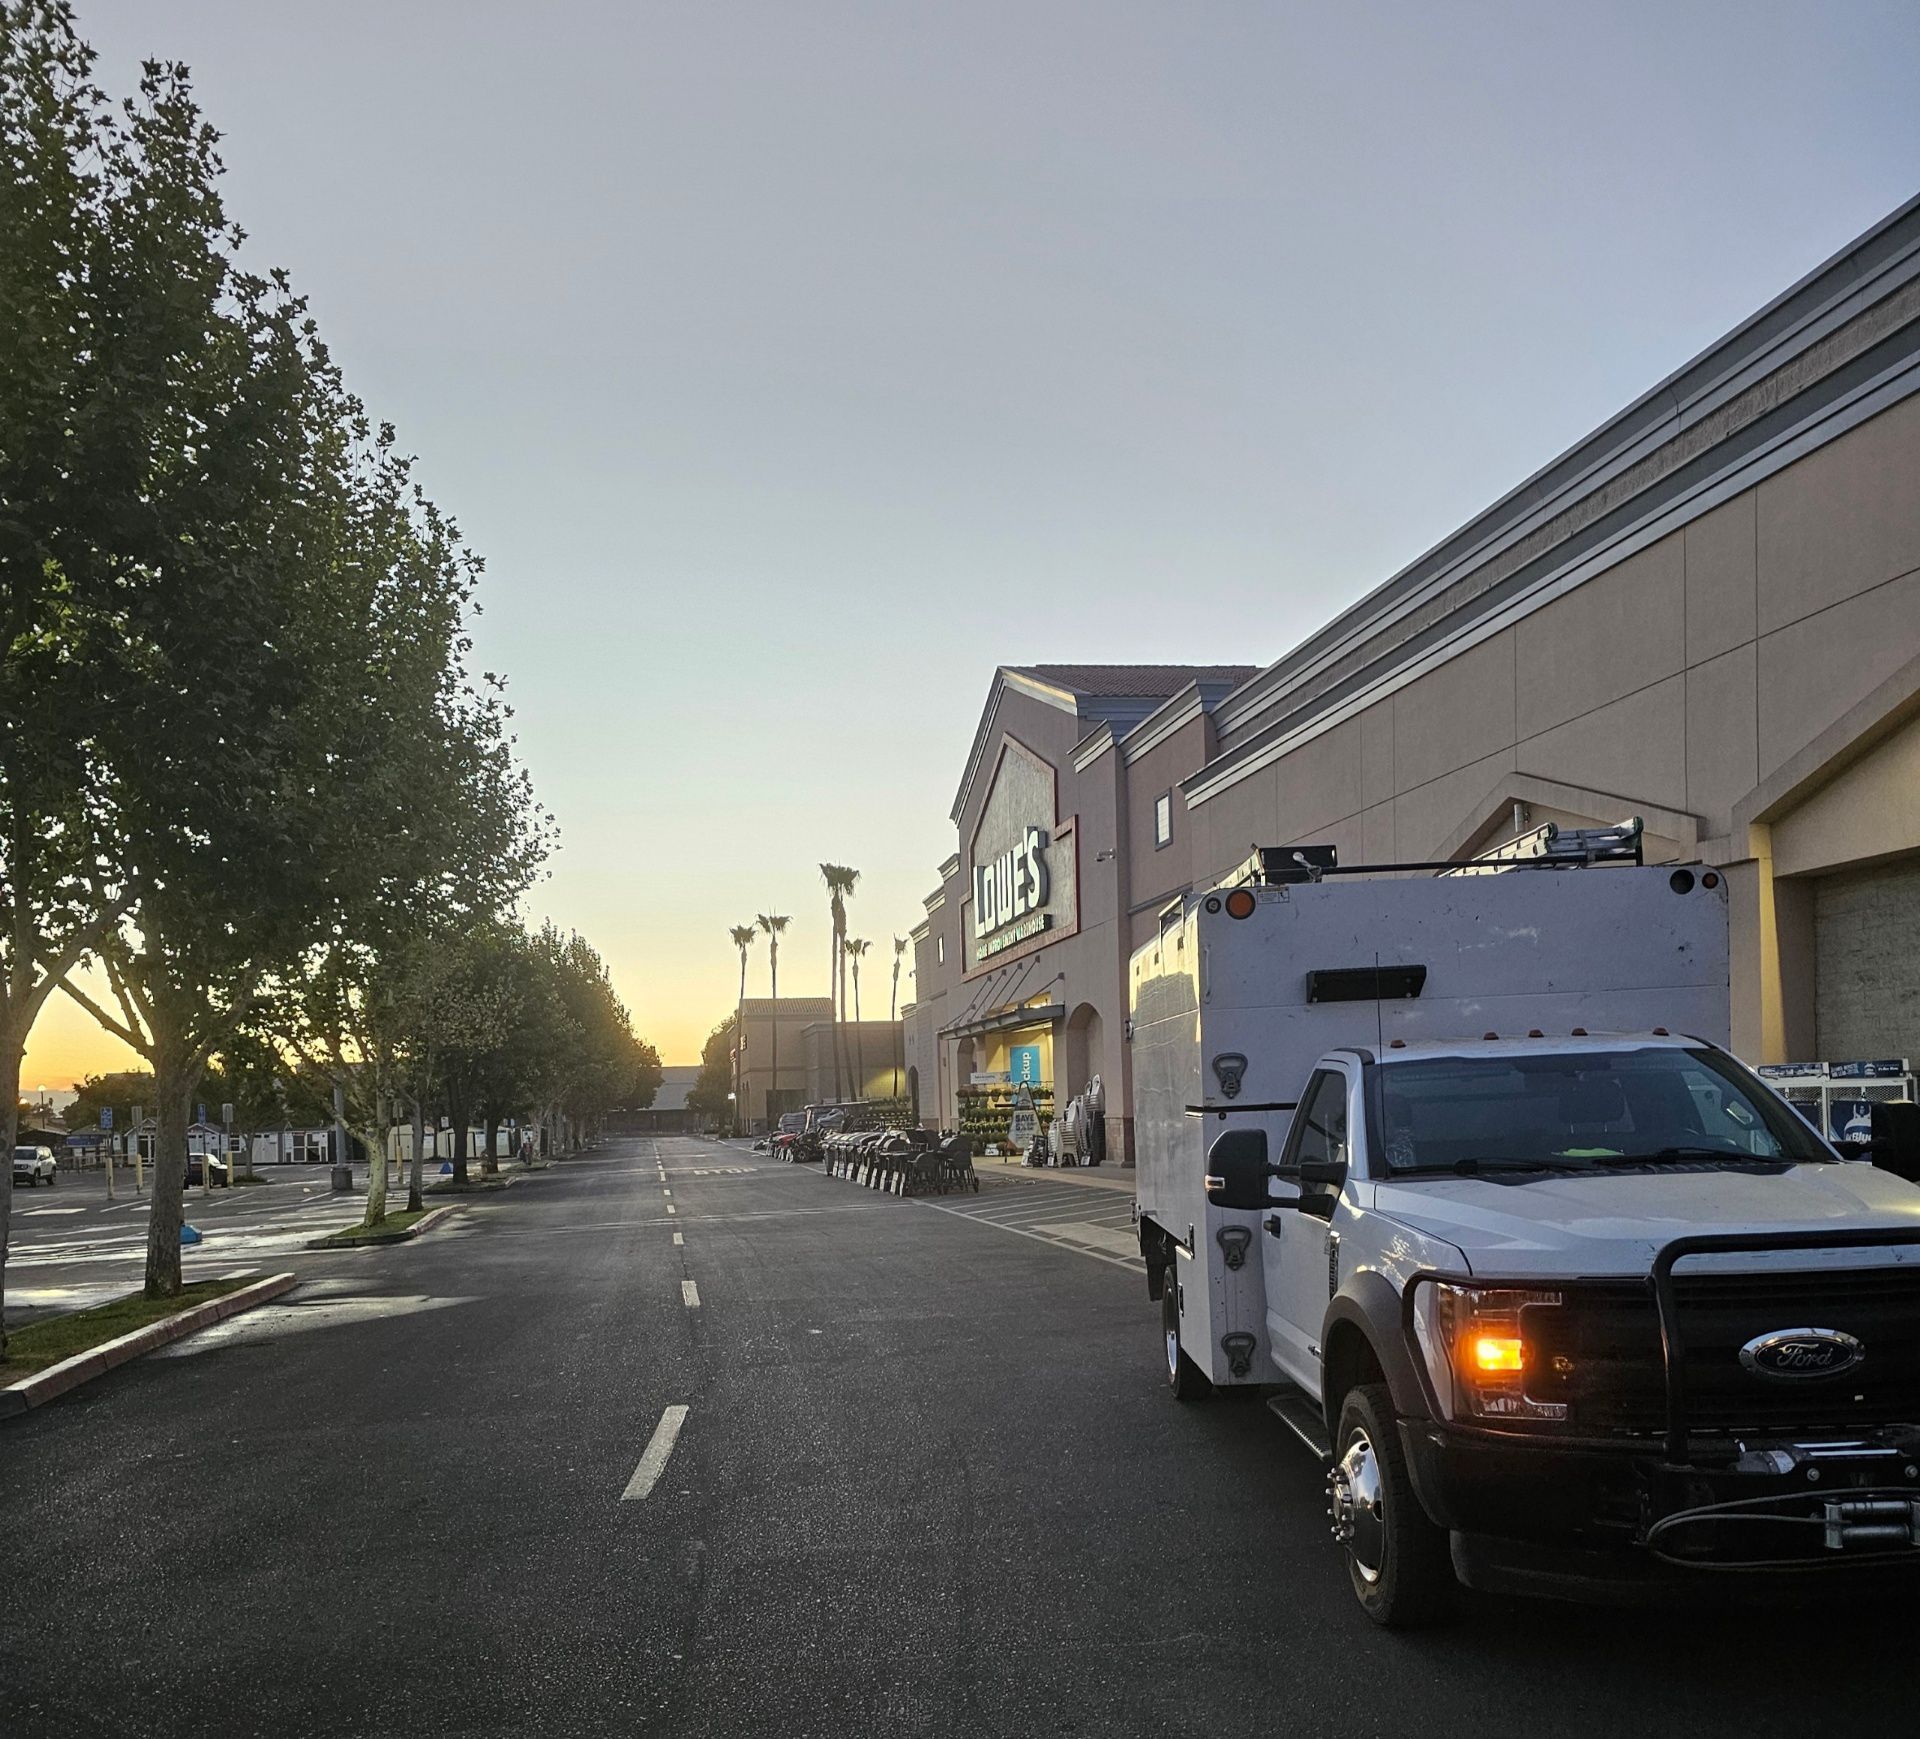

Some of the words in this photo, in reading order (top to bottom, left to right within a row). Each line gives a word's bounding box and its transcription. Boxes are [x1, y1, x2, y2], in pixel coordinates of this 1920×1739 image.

[973, 826, 1043, 939] LOWE'S
[1021, 1052, 1032, 1081] ckup
[1776, 1342, 1834, 1367] Ford
